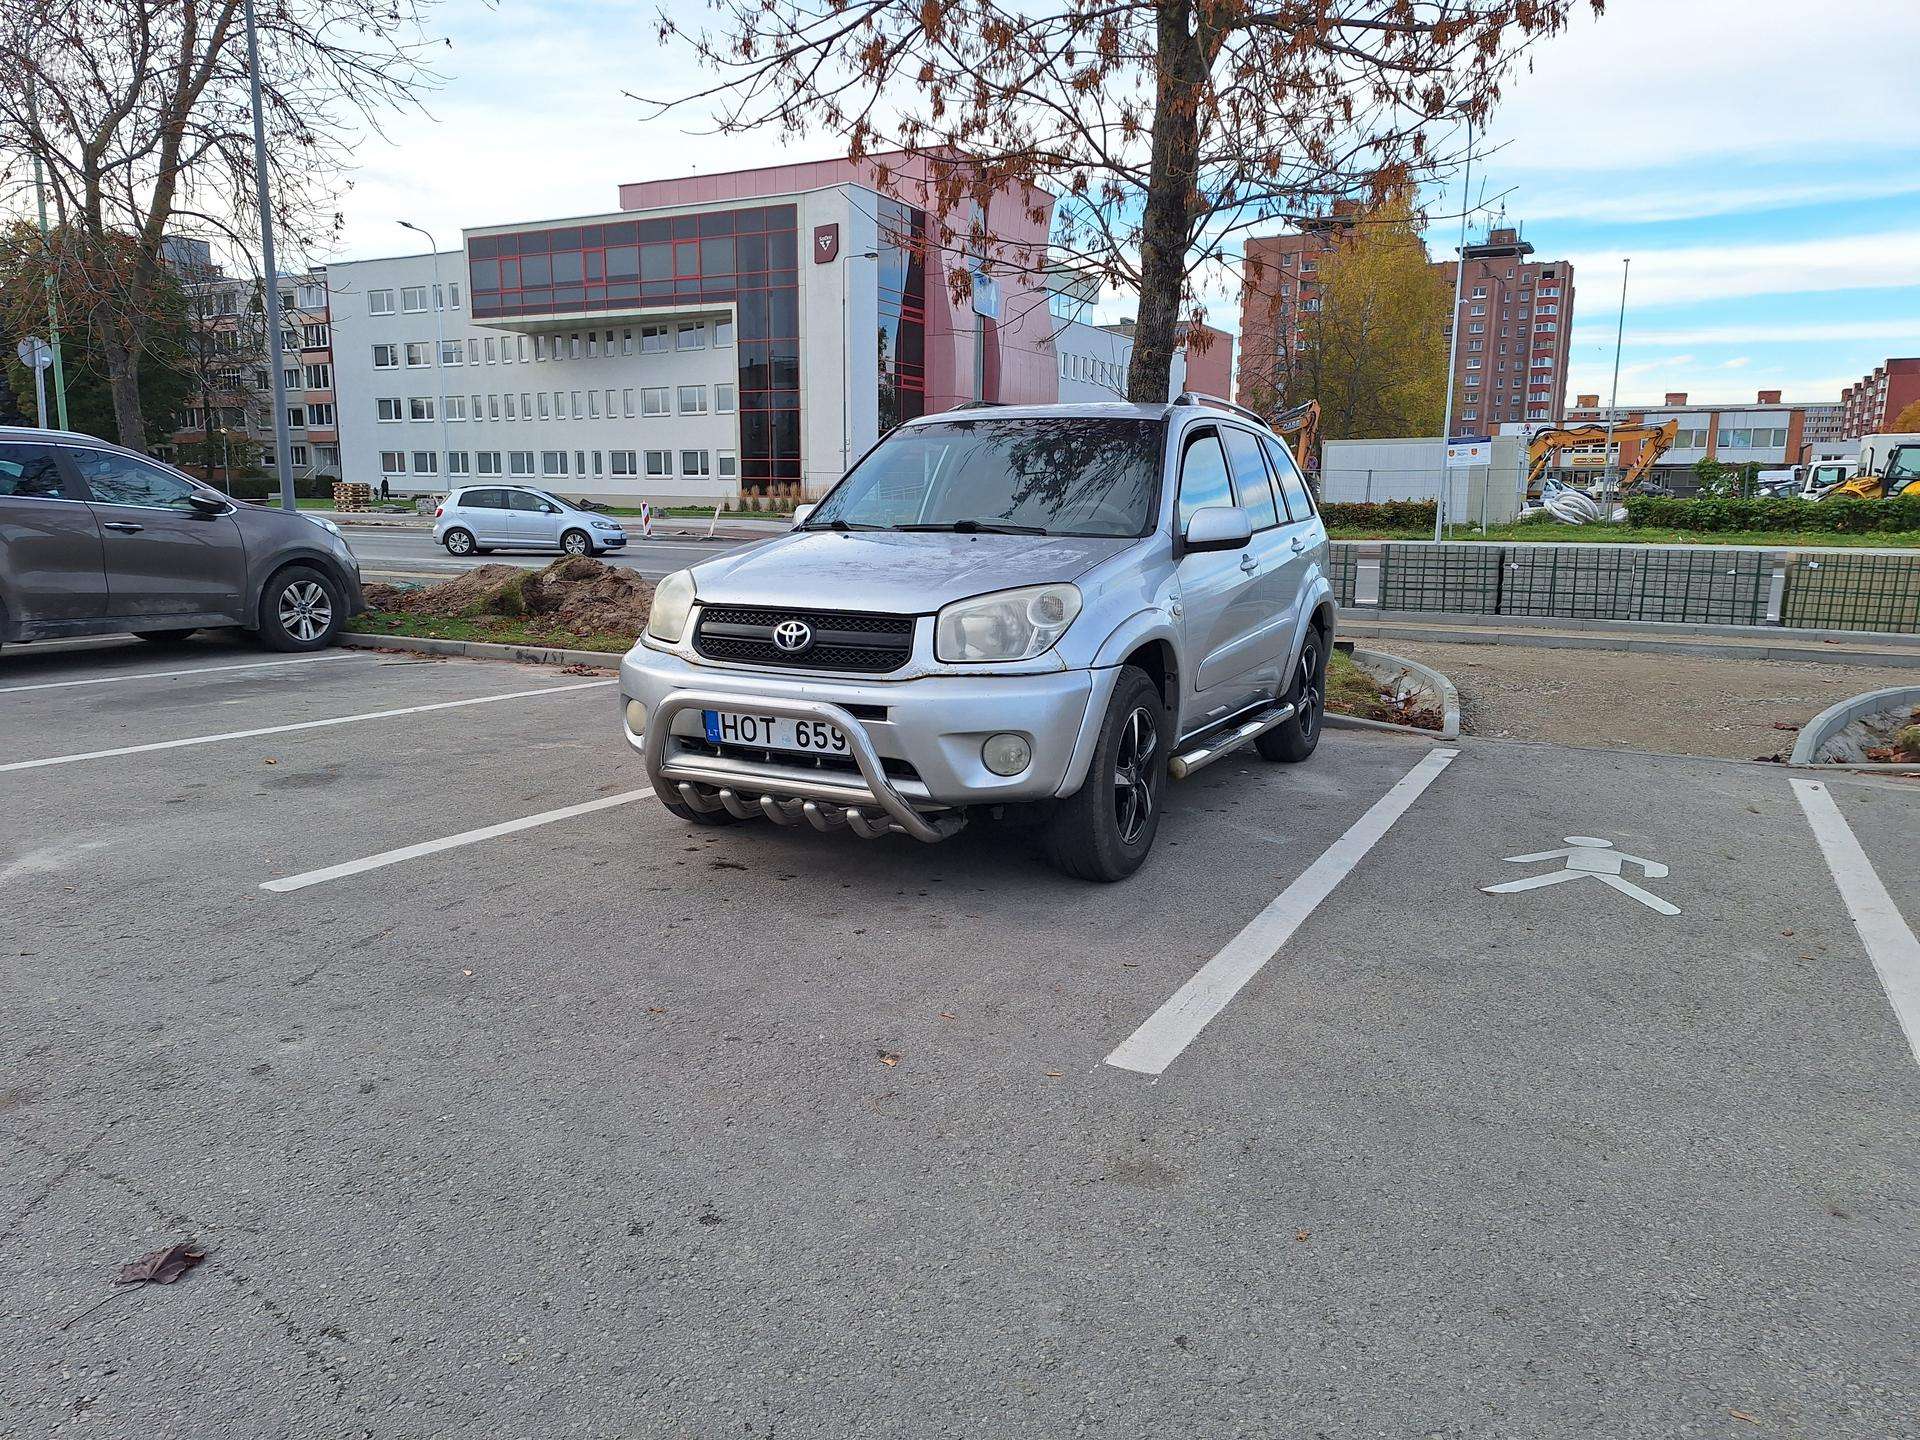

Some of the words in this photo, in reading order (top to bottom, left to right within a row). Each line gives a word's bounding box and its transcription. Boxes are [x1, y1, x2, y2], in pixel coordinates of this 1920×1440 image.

[707, 728, 719, 737] LT
[720, 713, 776, 744] HOT
[795, 720, 846, 751] 659
